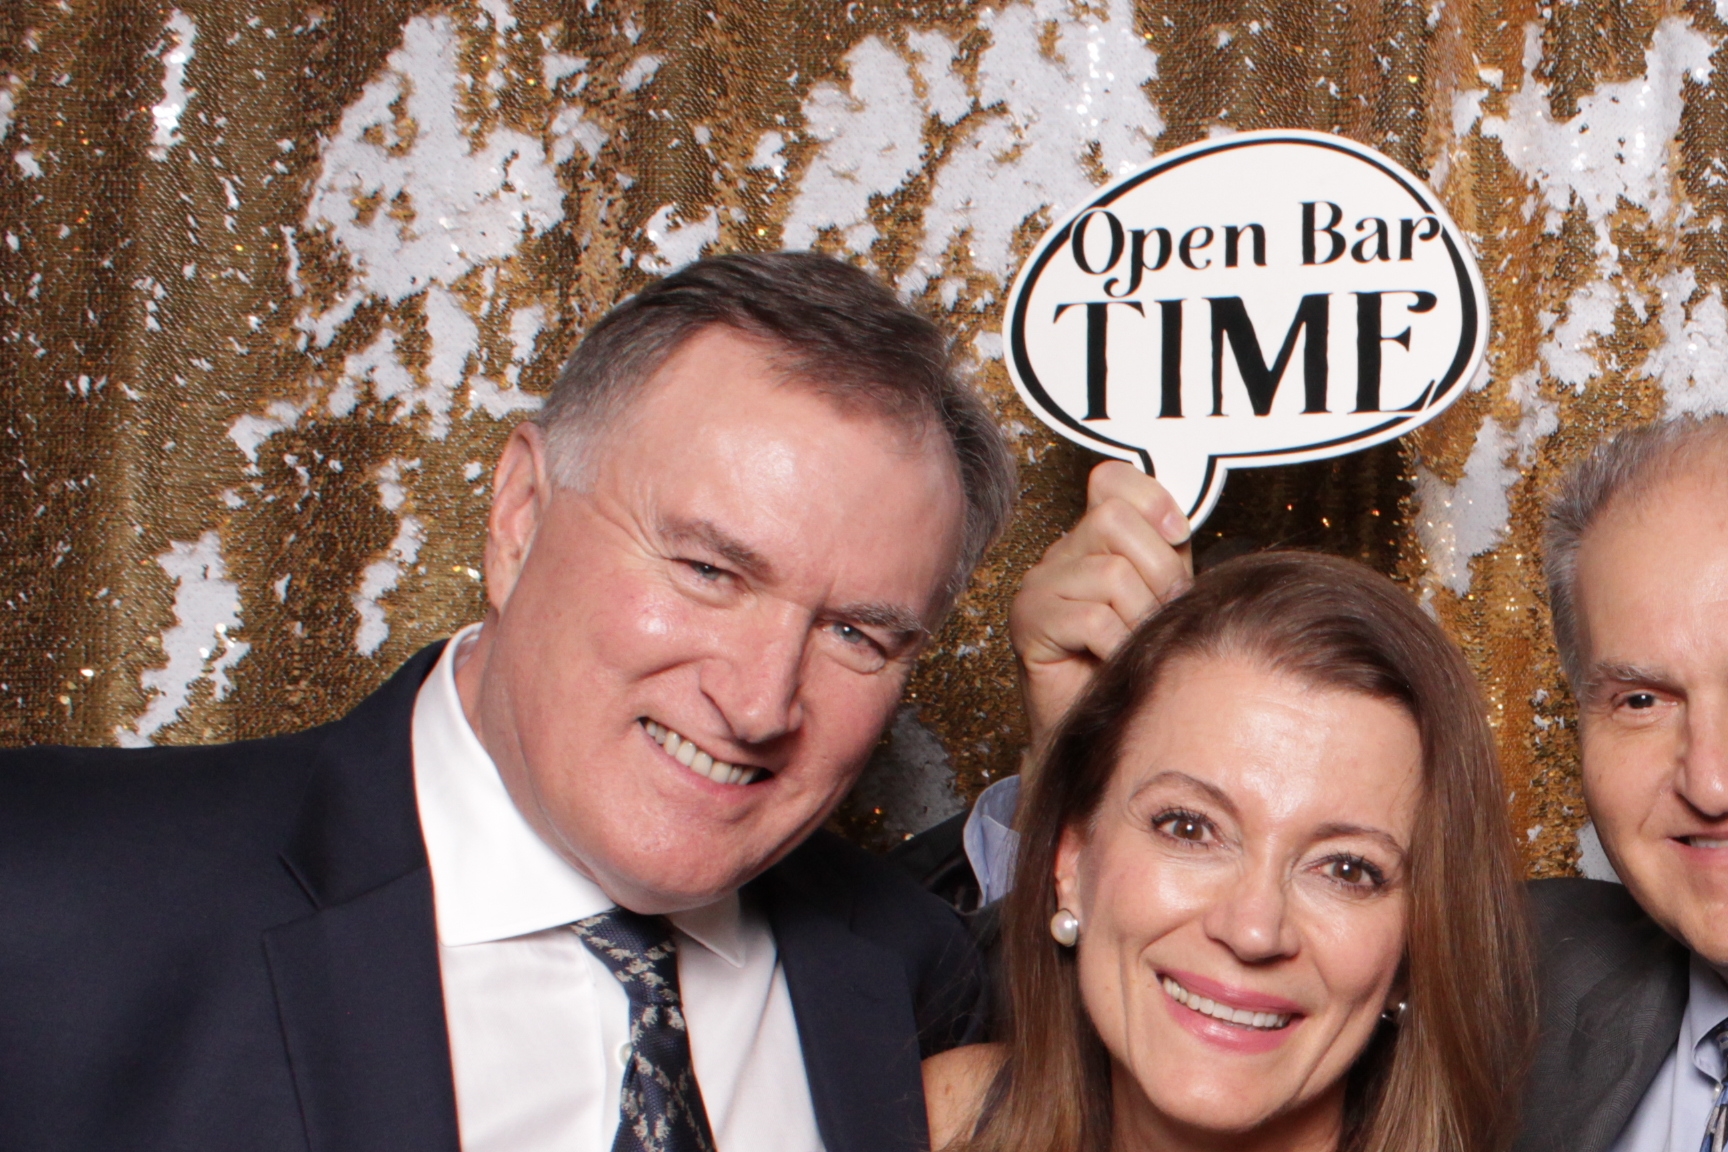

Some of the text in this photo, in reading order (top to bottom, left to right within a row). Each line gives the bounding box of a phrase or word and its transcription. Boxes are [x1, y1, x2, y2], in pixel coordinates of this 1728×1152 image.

[1071, 200, 1440, 298] Open Bar
[1053, 290, 1438, 421] TIME
